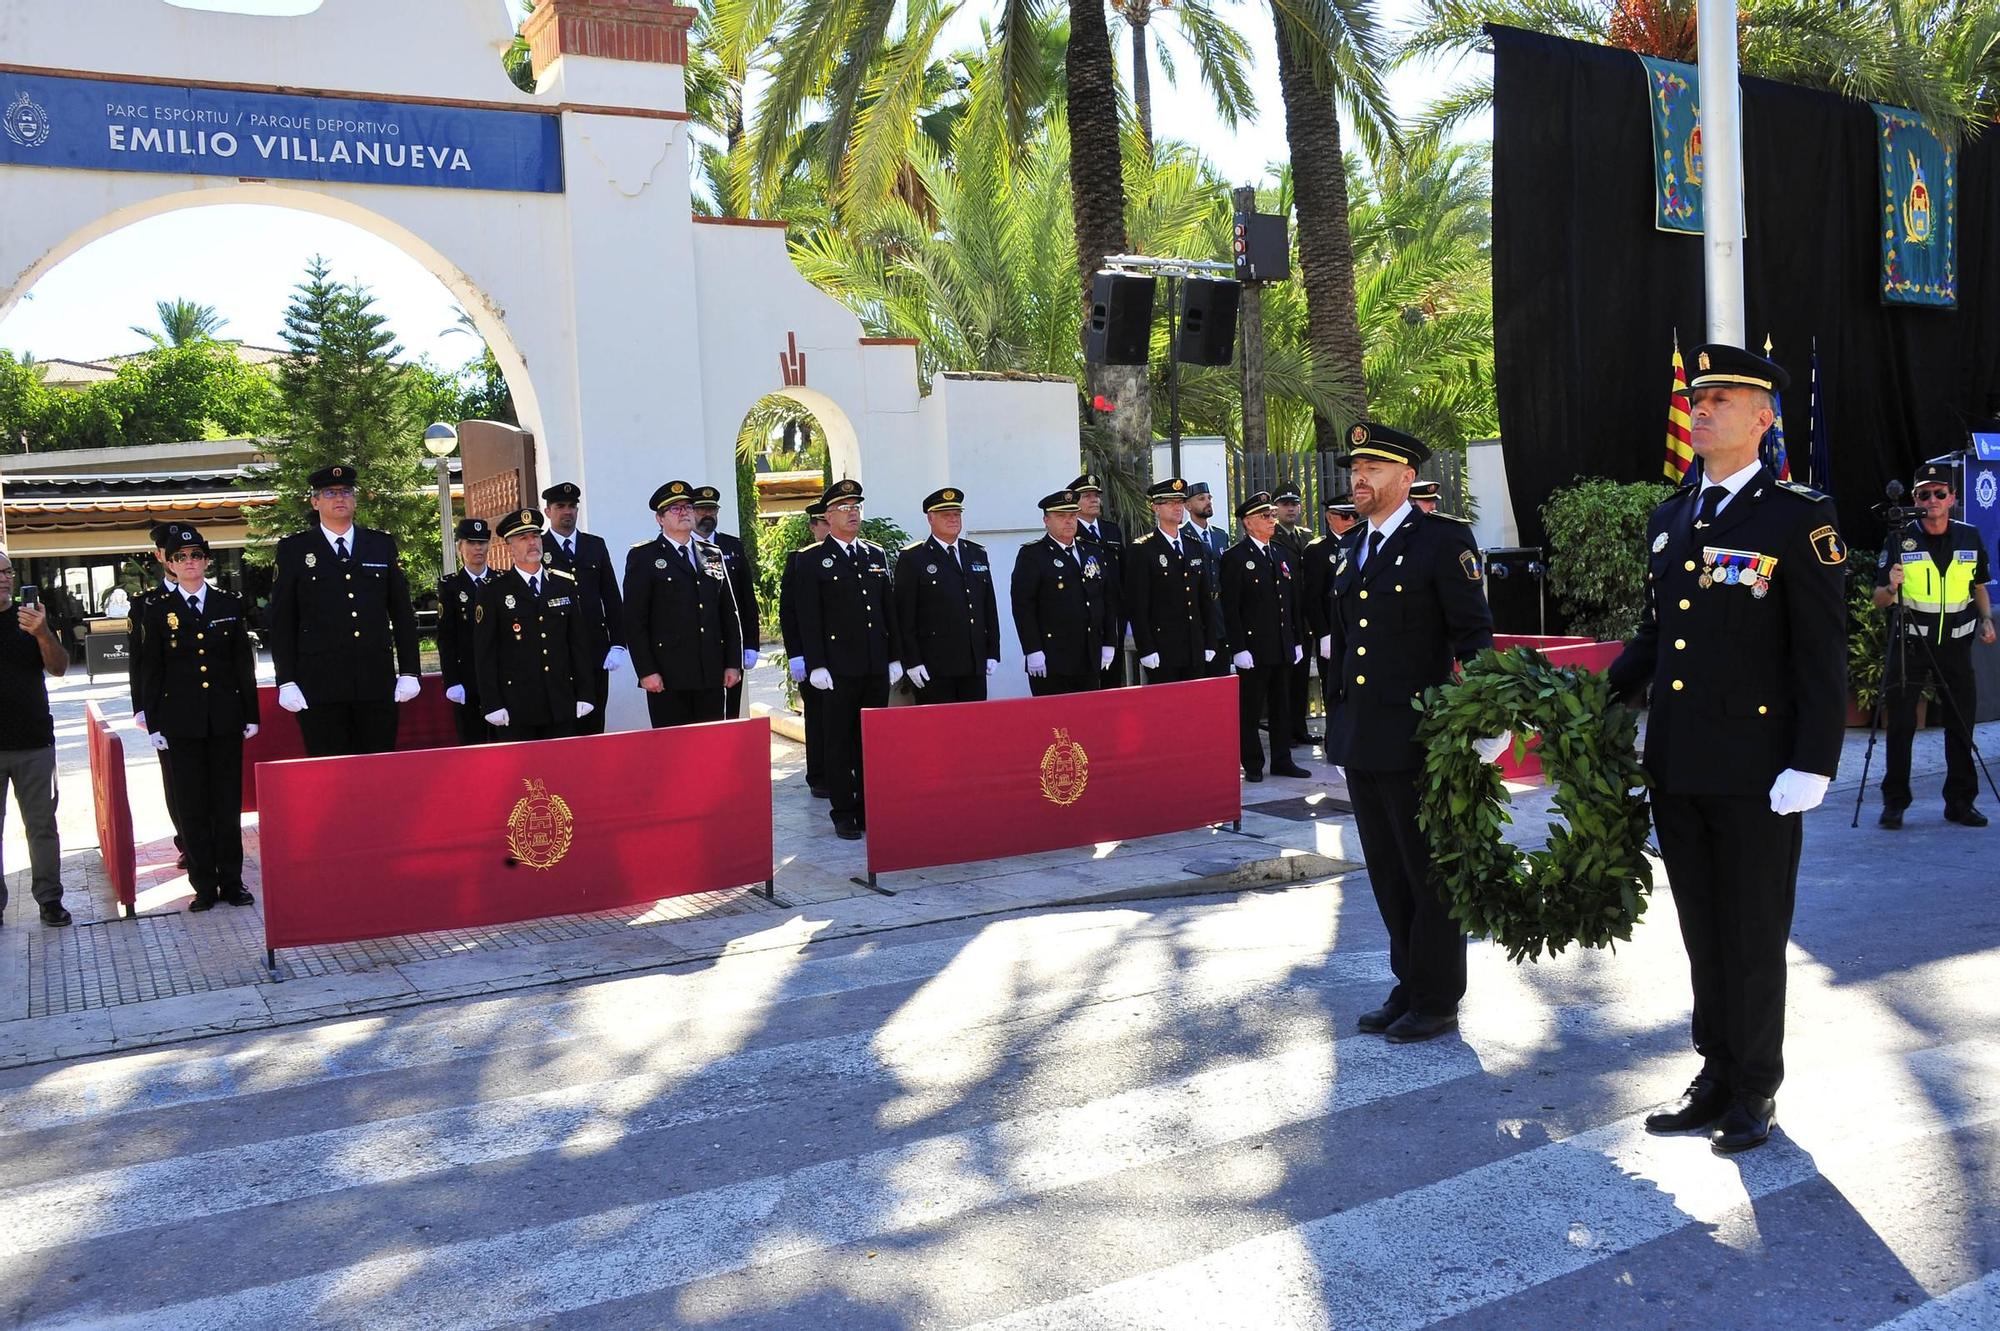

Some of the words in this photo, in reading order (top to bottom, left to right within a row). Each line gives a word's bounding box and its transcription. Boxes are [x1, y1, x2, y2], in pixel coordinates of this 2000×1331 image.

[106, 103, 148, 119] PARC
[155, 107, 229, 124] ESPORTIU
[235, 112, 244, 126] /
[250, 114, 311, 130] PARQUE
[317, 118, 400, 136] DEPORTIVO
[108, 125, 238, 157] EMILIO
[251, 134, 472, 171] VILLANUEVA
[547, 802, 564, 836] COLONIA
